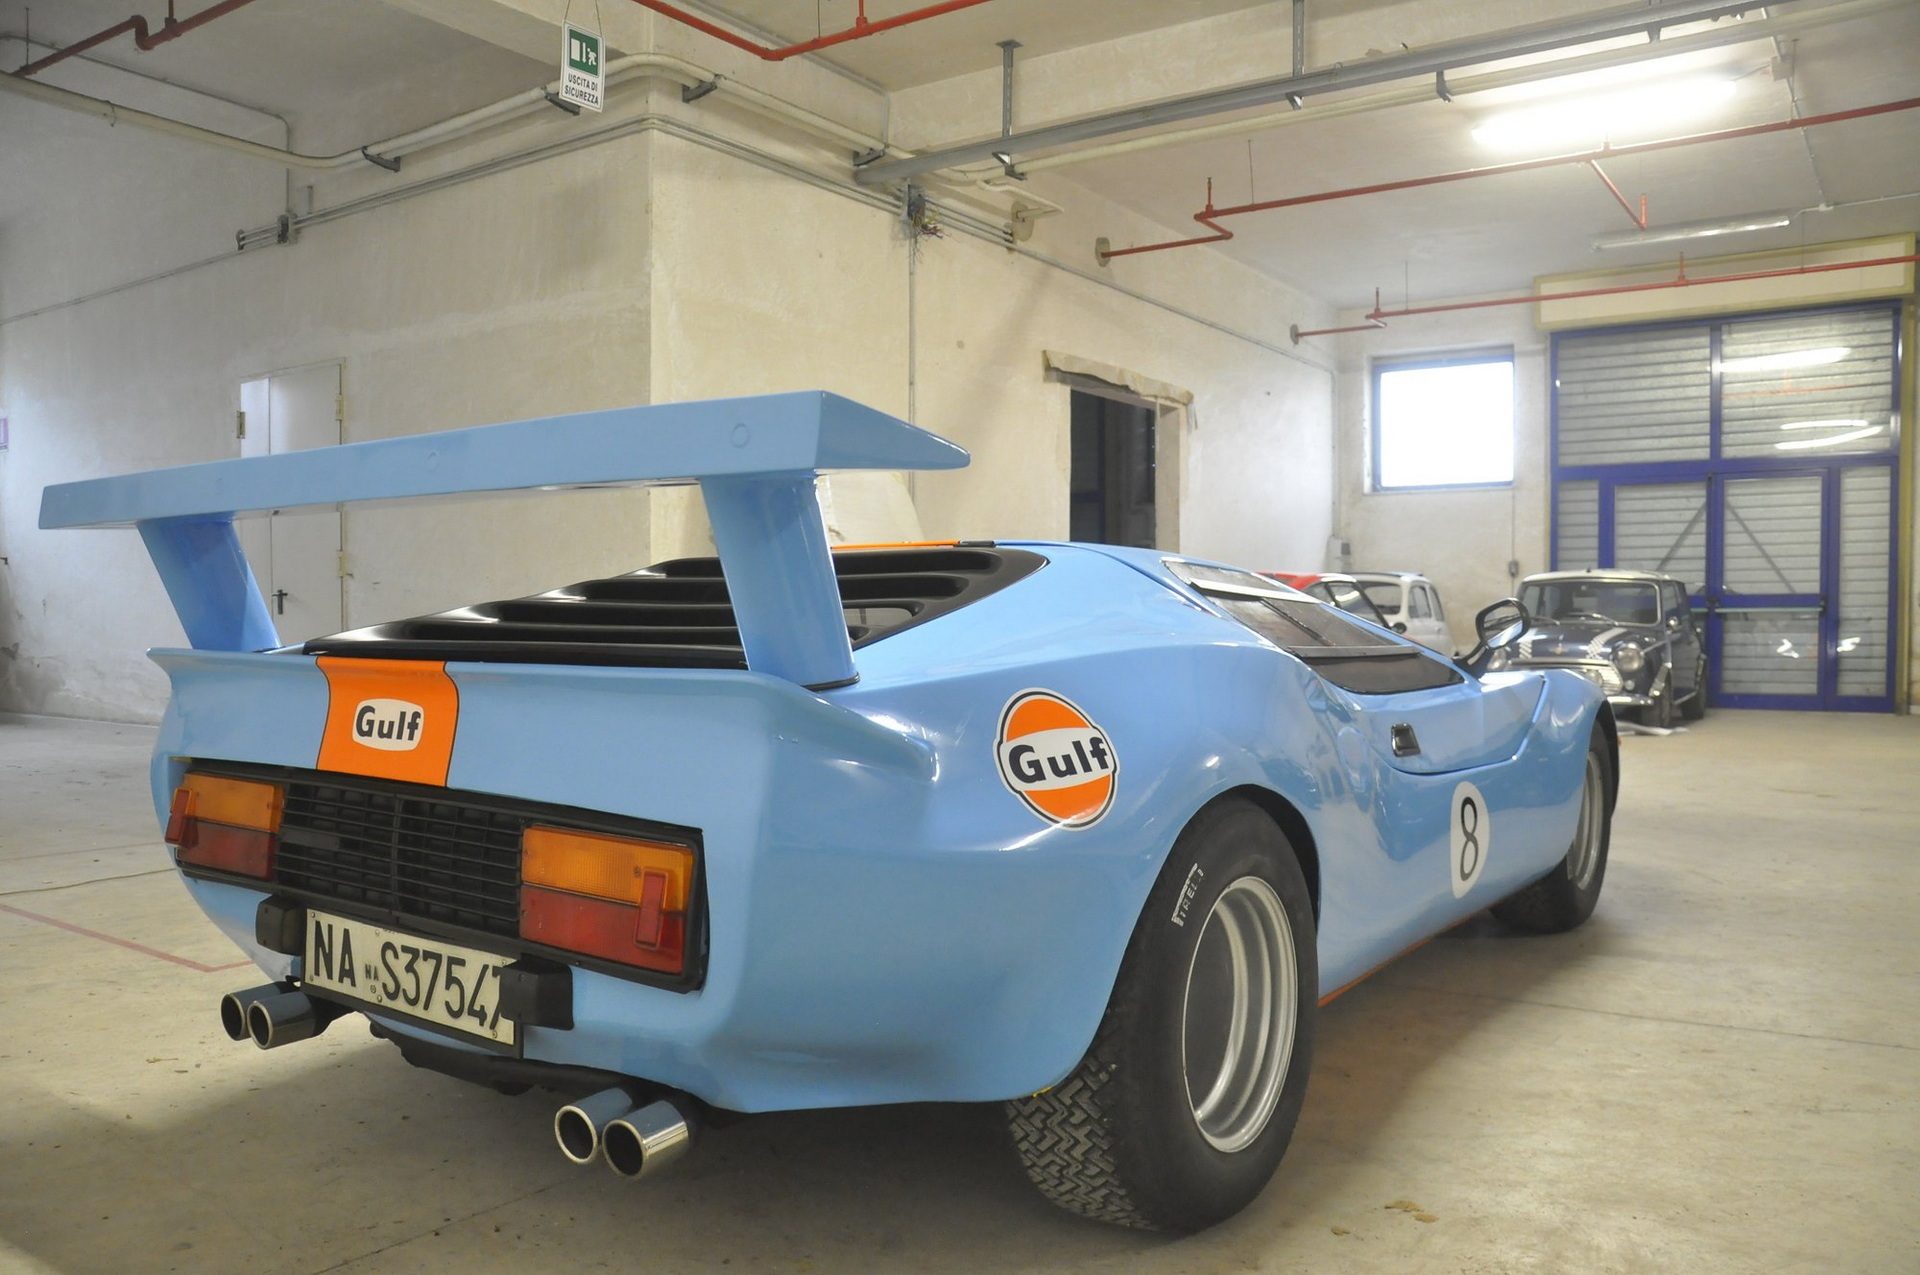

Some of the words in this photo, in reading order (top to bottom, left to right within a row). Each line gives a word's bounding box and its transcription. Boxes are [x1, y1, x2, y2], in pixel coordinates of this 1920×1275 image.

[564, 85, 599, 105] SICUREZZA
[568, 73, 591, 89] USCITA
[591, 81, 598, 92] DI
[356, 705, 421, 741] Gulf
[1008, 736, 1109, 784] Gulf
[1460, 796, 1479, 881] 8
[314, 920, 356, 987] NA
[365, 963, 379, 981] NA
